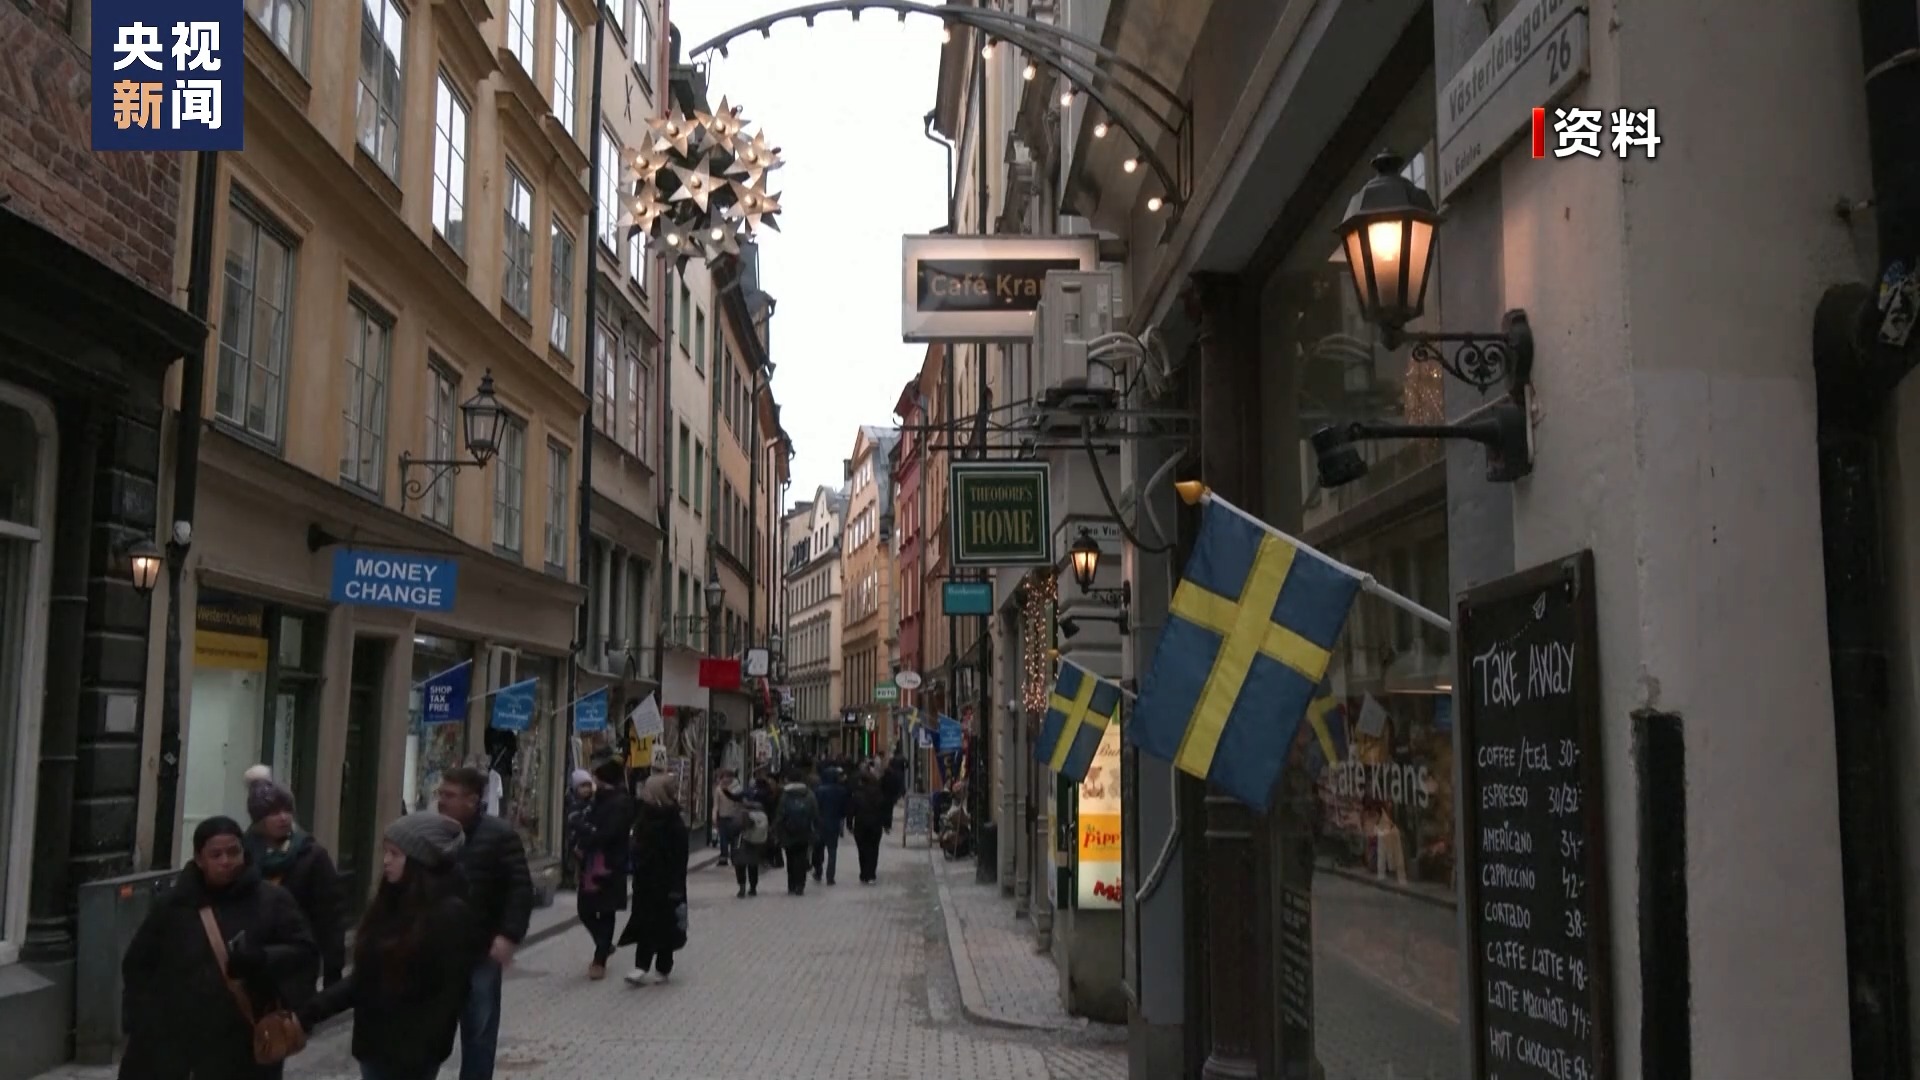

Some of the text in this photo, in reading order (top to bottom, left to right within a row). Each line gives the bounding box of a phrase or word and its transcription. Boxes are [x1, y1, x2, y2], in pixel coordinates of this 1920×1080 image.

[1546, 28, 1571, 86] 26
[931, 272, 1045, 297] Café Kra
[971, 509, 1034, 545] HOME
[355, 558, 438, 583] MONEY
[345, 580, 443, 606] CHANGE
[430, 685, 453, 695] SHOP
[430, 695, 446, 703] TAX
[428, 703, 451, 713] FREE
[1482, 783, 1529, 809] ESPRESSO
[1489, 1025, 1513, 1061] HOT
